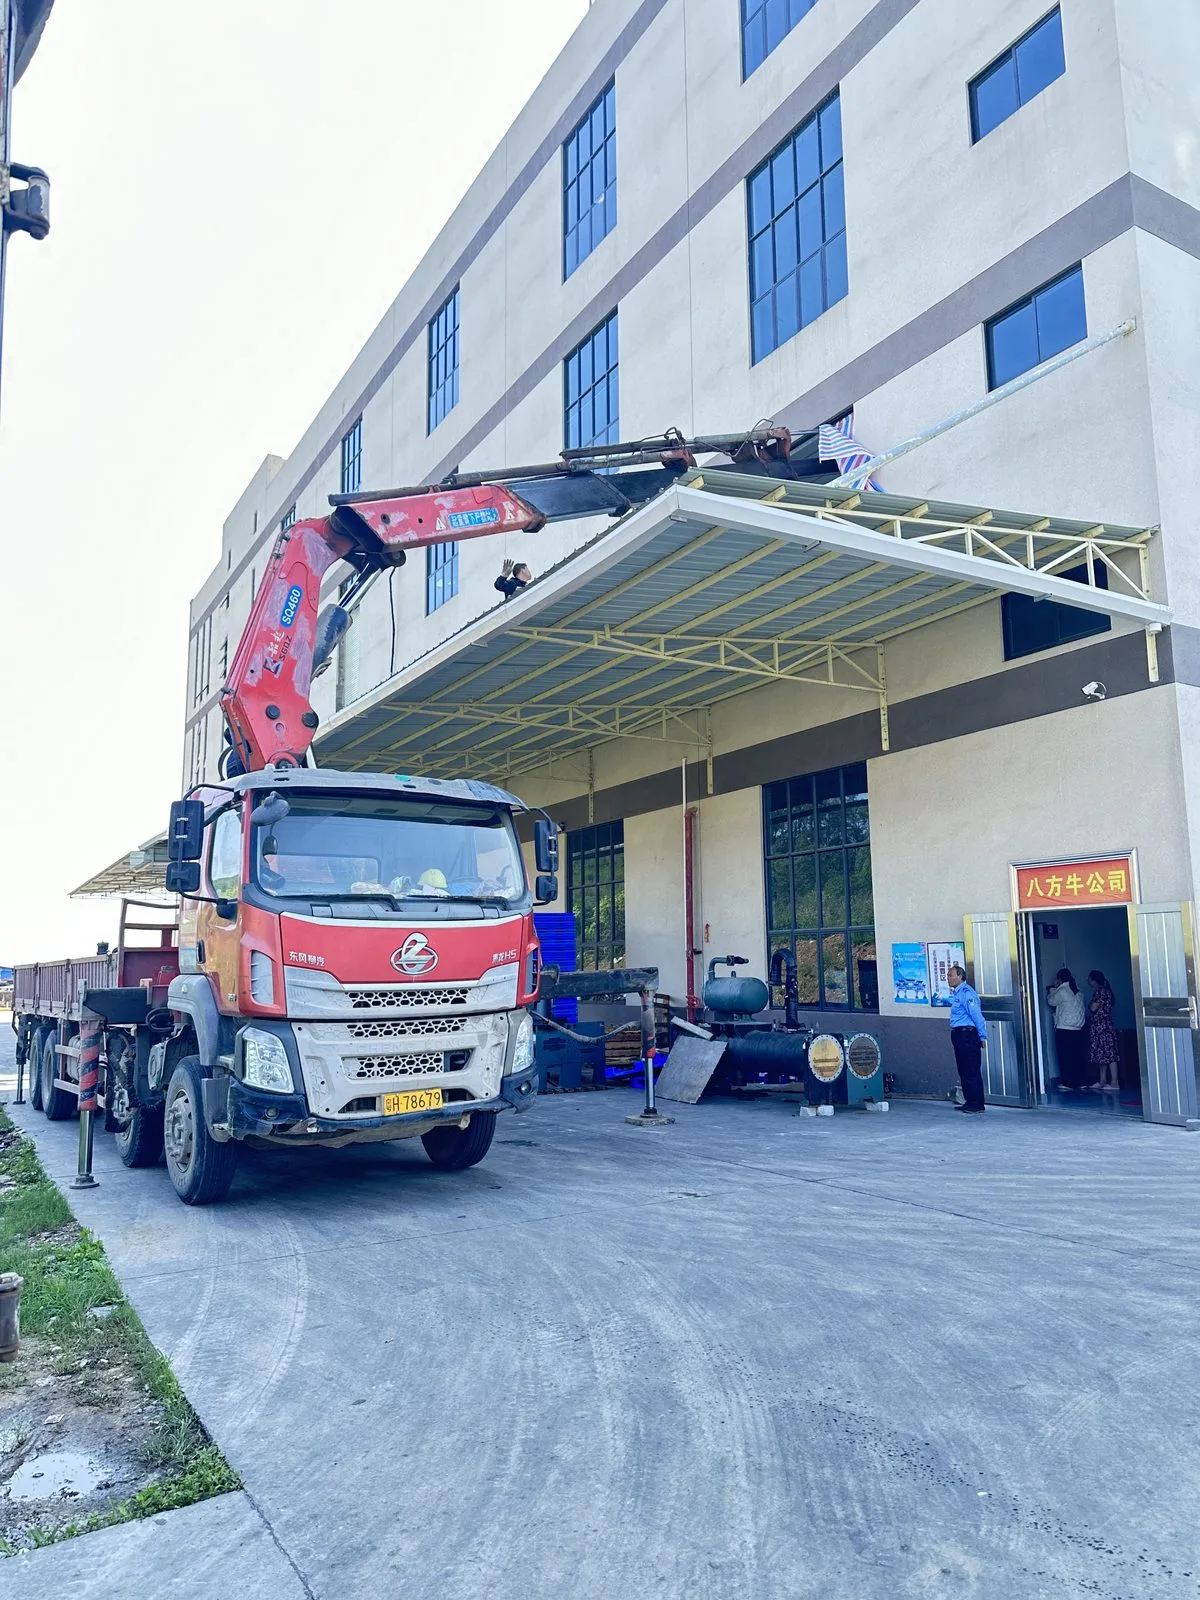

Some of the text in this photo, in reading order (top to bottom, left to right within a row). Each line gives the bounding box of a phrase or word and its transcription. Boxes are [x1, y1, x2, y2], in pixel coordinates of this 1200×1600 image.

[282, 588, 301, 625] SQ460
[1026, 870, 1127, 898] 八方牛公司
